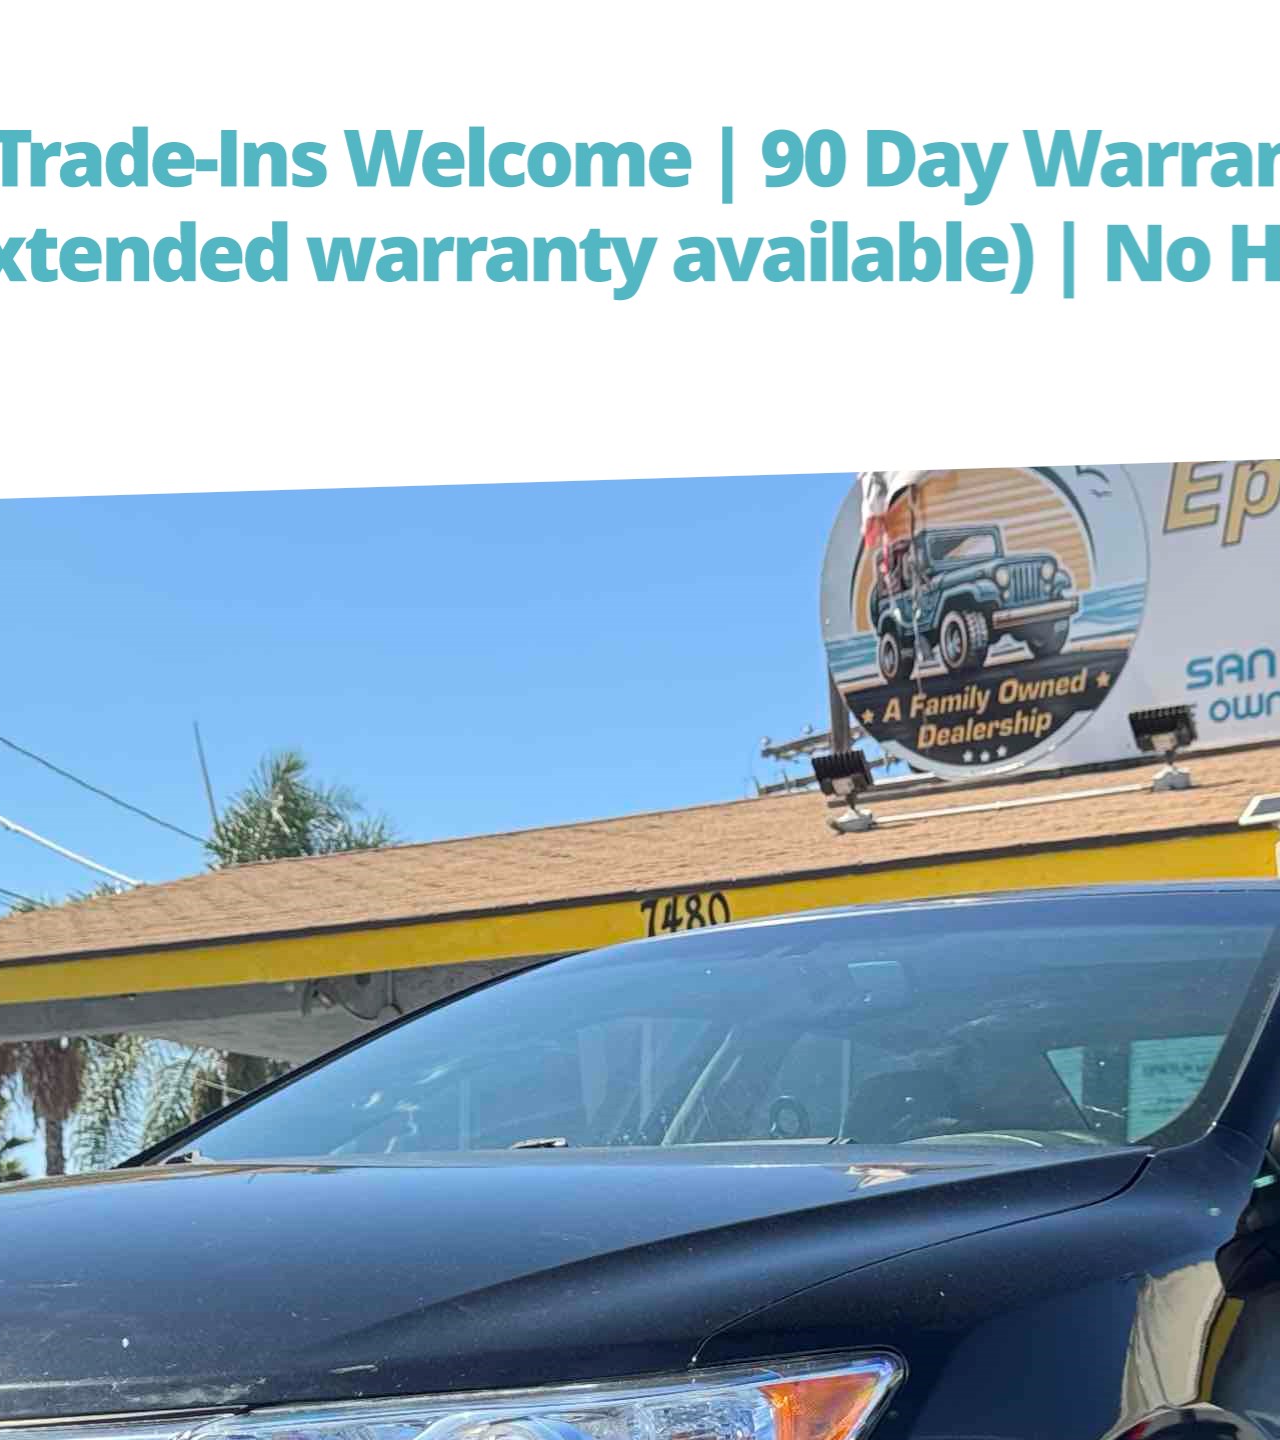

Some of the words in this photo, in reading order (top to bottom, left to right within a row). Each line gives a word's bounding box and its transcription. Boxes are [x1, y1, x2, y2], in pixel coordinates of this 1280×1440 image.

[1186, 648, 1276, 689] SAN
[882, 698, 901, 722] A
[910, 684, 990, 717] Family
[999, 667, 1088, 703] Owned
[917, 709, 1052, 749] Dealership
[641, 891, 730, 937] 7480
